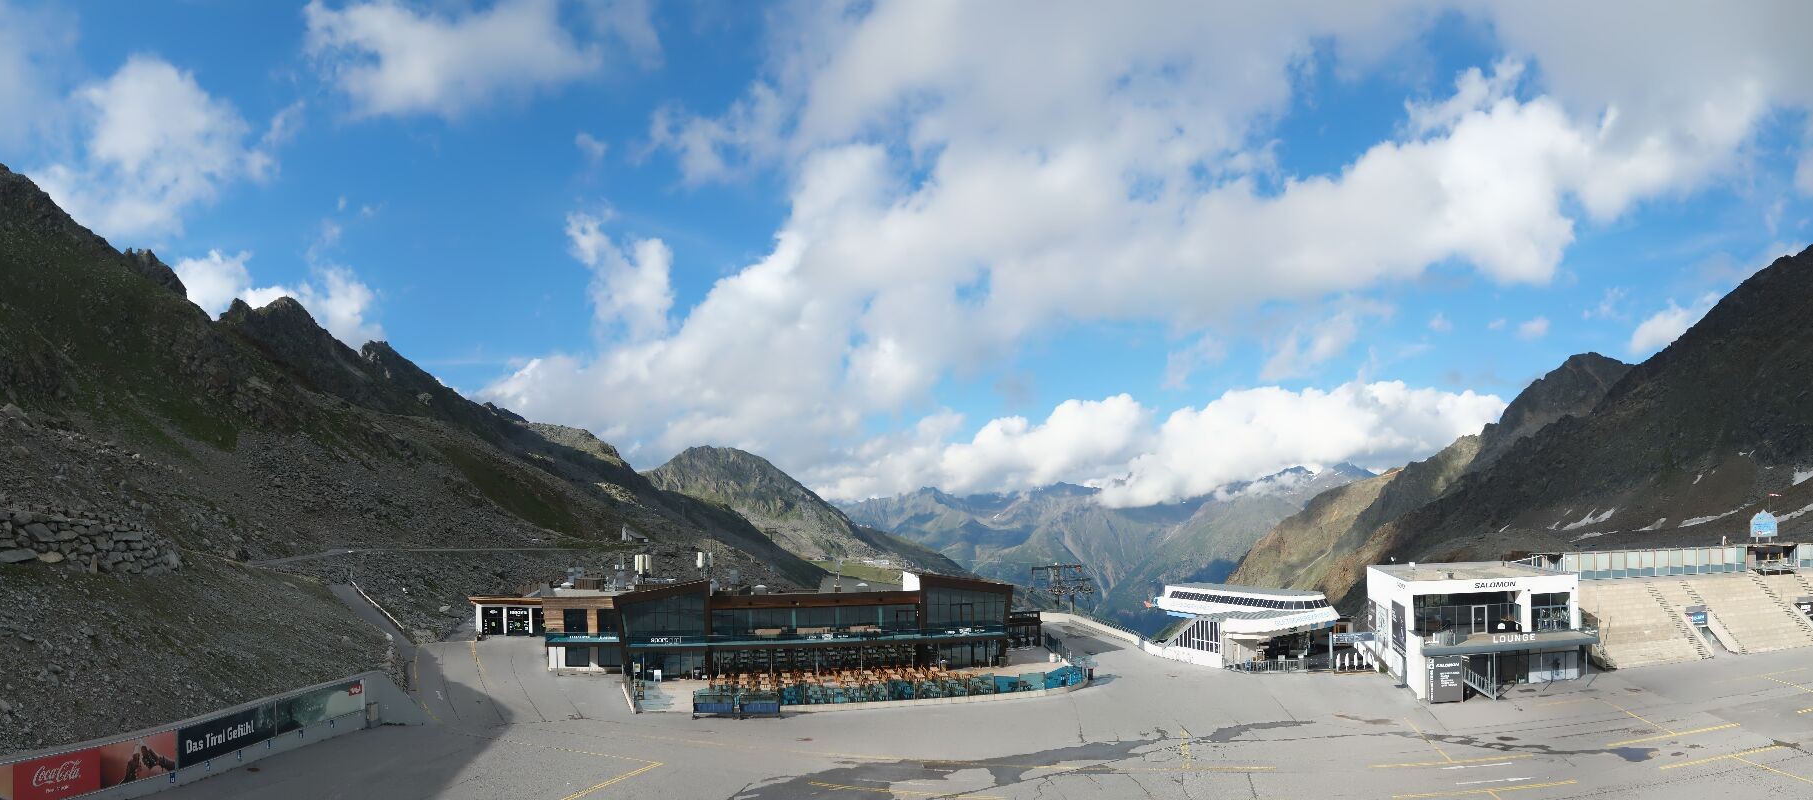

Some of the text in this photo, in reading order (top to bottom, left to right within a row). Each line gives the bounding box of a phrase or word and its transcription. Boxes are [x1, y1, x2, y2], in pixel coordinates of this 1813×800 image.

[1474, 581, 1516, 589] SALOMON
[1493, 633, 1536, 643] LOUNGE
[186, 719, 255, 755] Das Tirol Gefühl
[32, 760, 82, 787] Coca-Cola
